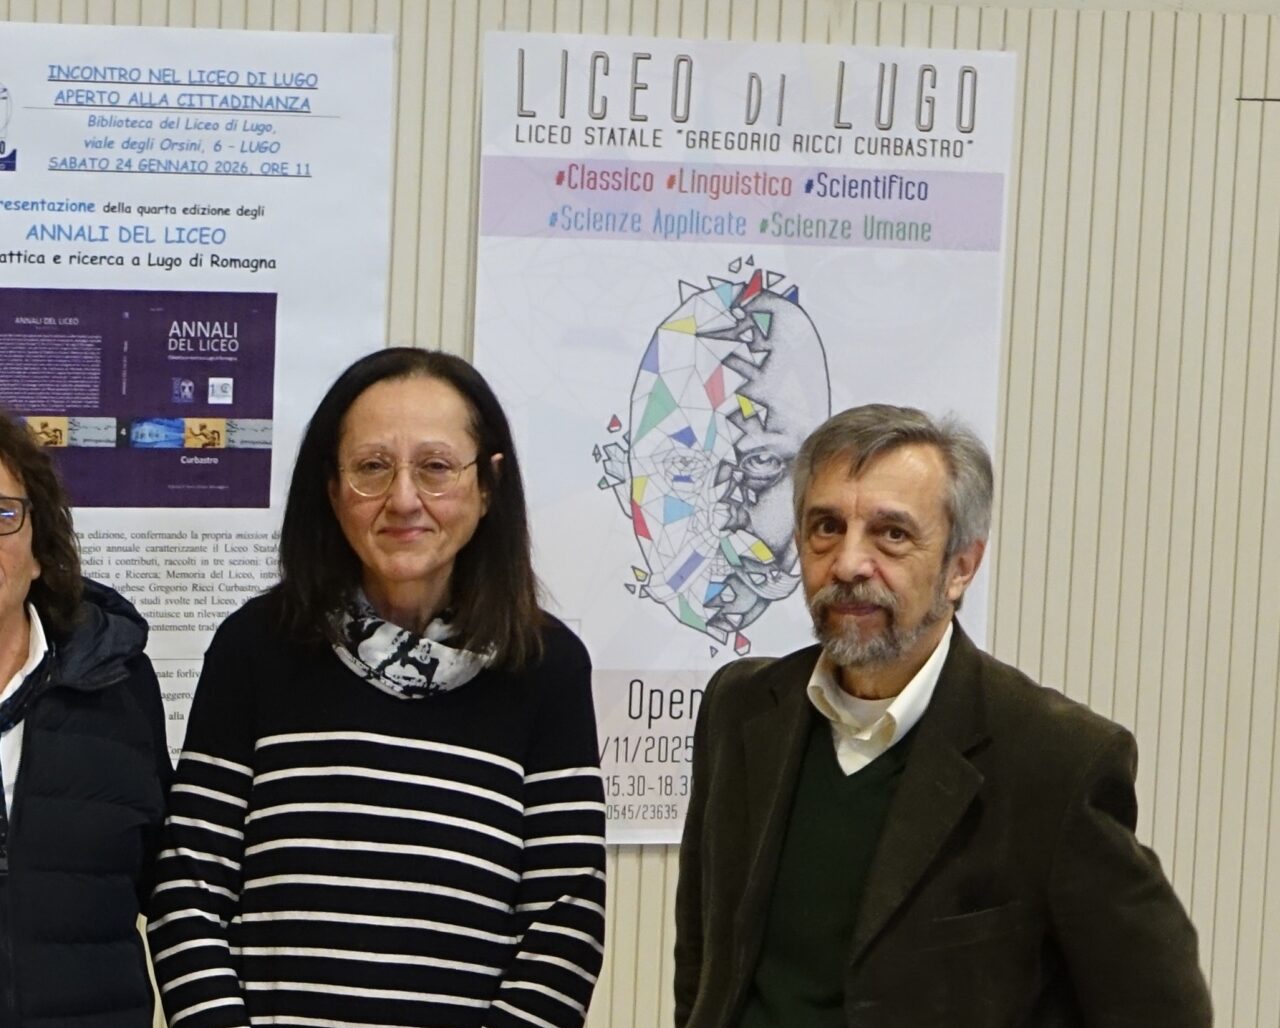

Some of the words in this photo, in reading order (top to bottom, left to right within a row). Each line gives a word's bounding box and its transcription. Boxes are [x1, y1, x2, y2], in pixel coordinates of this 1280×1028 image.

[48, 65, 142, 82] INCONTRO
[148, 68, 181, 84] NEL
[188, 69, 239, 85] LICEO
[247, 71, 267, 86] DI
[273, 72, 318, 88] LUGO
[54, 89, 121, 106] APERTO
[127, 91, 169, 107] ALLA
[177, 93, 311, 110] CITTADINANZA
[517, 47, 693, 124] LICEO
[745, 71, 786, 127] DI
[834, 60, 978, 134] LUGO
[87, 114, 153, 129] Biblioteca
[159, 116, 180, 129] del
[184, 117, 219, 131] Liceo
[225, 119, 239, 132] di
[242, 119, 276, 136] Lugo,
[84, 136, 115, 149] viale
[121, 137, 155, 154] degli
[159, 138, 205, 154] Orsini,
[213, 139, 222, 152] 6
[240, 140, 281, 154] LUGO
[515, 123, 572, 145] LICEO
[584, 126, 663, 148] STATALE
[676, 128, 781, 152] "GREGORIO
[793, 133, 842, 154] RICCI
[854, 136, 974, 159] CURBASTRO"
[48, 156, 110, 170] SABATO
[115, 157, 132, 171] 24
[138, 158, 208, 173] GENNAIO
[260, 161, 289, 176] ORE
[296, 162, 311, 176] 11
[556, 163, 655, 192] #Classico
[666, 167, 793, 201] #Linguistico
[804, 171, 929, 201] #Scientifico
[103, 201, 132, 214] della
[137, 204, 177, 218] quarta
[182, 203, 231, 216] edizione
[236, 205, 266, 220] degli
[548, 204, 642, 233] #Scienze
[653, 208, 747, 240] Applicate
[759, 211, 852, 238] #Scienze
[863, 214, 932, 242] Umane
[26, 223, 110, 242] ANNALI
[119, 225, 156, 244] DEL
[164, 226, 227, 245] LICEO
[53, 253, 62, 265] e
[69, 251, 124, 267] ricerca
[131, 255, 141, 267] a
[147, 252, 183, 272] Lugo
[189, 253, 203, 268] di
[210, 253, 277, 273] Romagna
[168, 320, 238, 338] ANNALI
[168, 338, 195, 351] DEL
[199, 339, 239, 352] LICEO
[180, 455, 219, 464] Curbastro
[130, 530, 188, 540] confermando
[201, 532, 233, 541] propria
[106, 543, 141, 553] annuale
[164, 556, 197, 566] raccolti
[599, 735, 695, 764] /11/2025
[606, 803, 678, 821] 0545/23635
